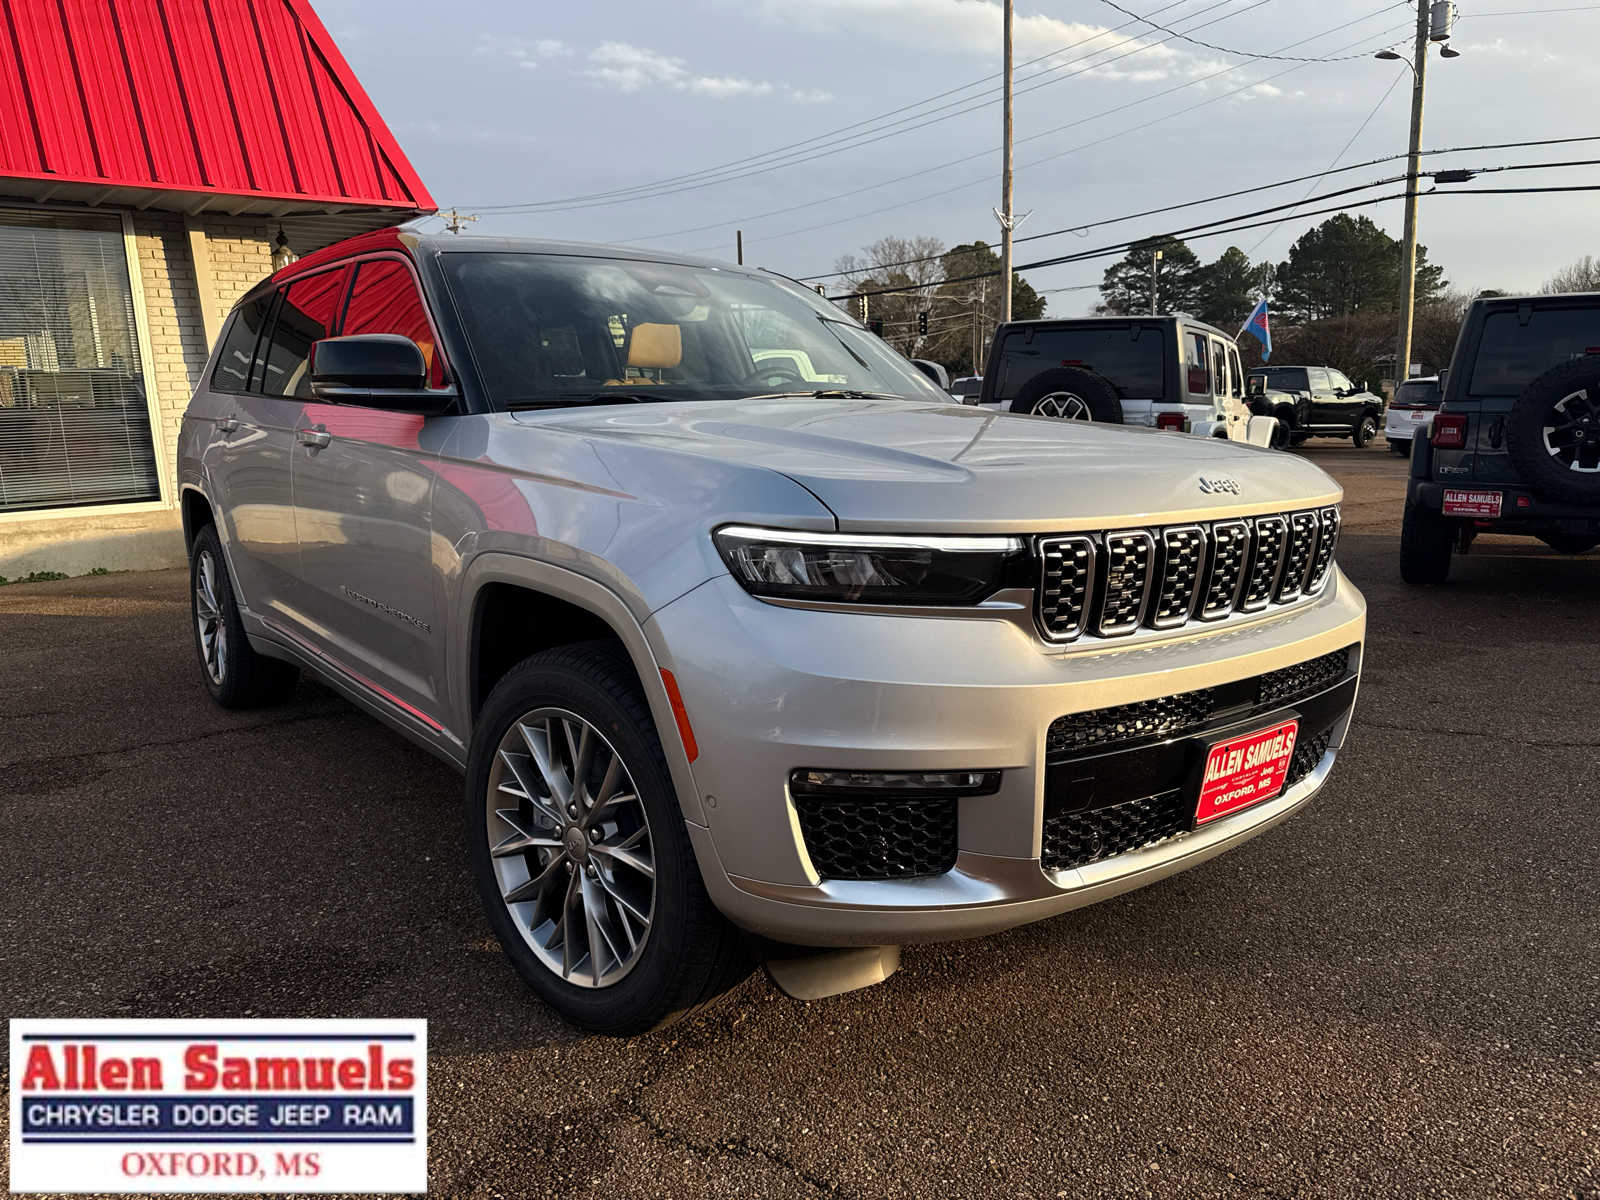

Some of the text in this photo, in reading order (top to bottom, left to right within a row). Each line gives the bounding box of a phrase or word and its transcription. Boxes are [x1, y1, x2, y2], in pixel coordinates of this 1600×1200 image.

[1199, 476, 1240, 496] Jeep
[1445, 493, 1500, 505] ALLEN SAMUELS
[1204, 731, 1294, 784] ALLEN SAMUELS
[1214, 784, 1256, 806] OXFORD,
[1258, 777, 1272, 790] MS
